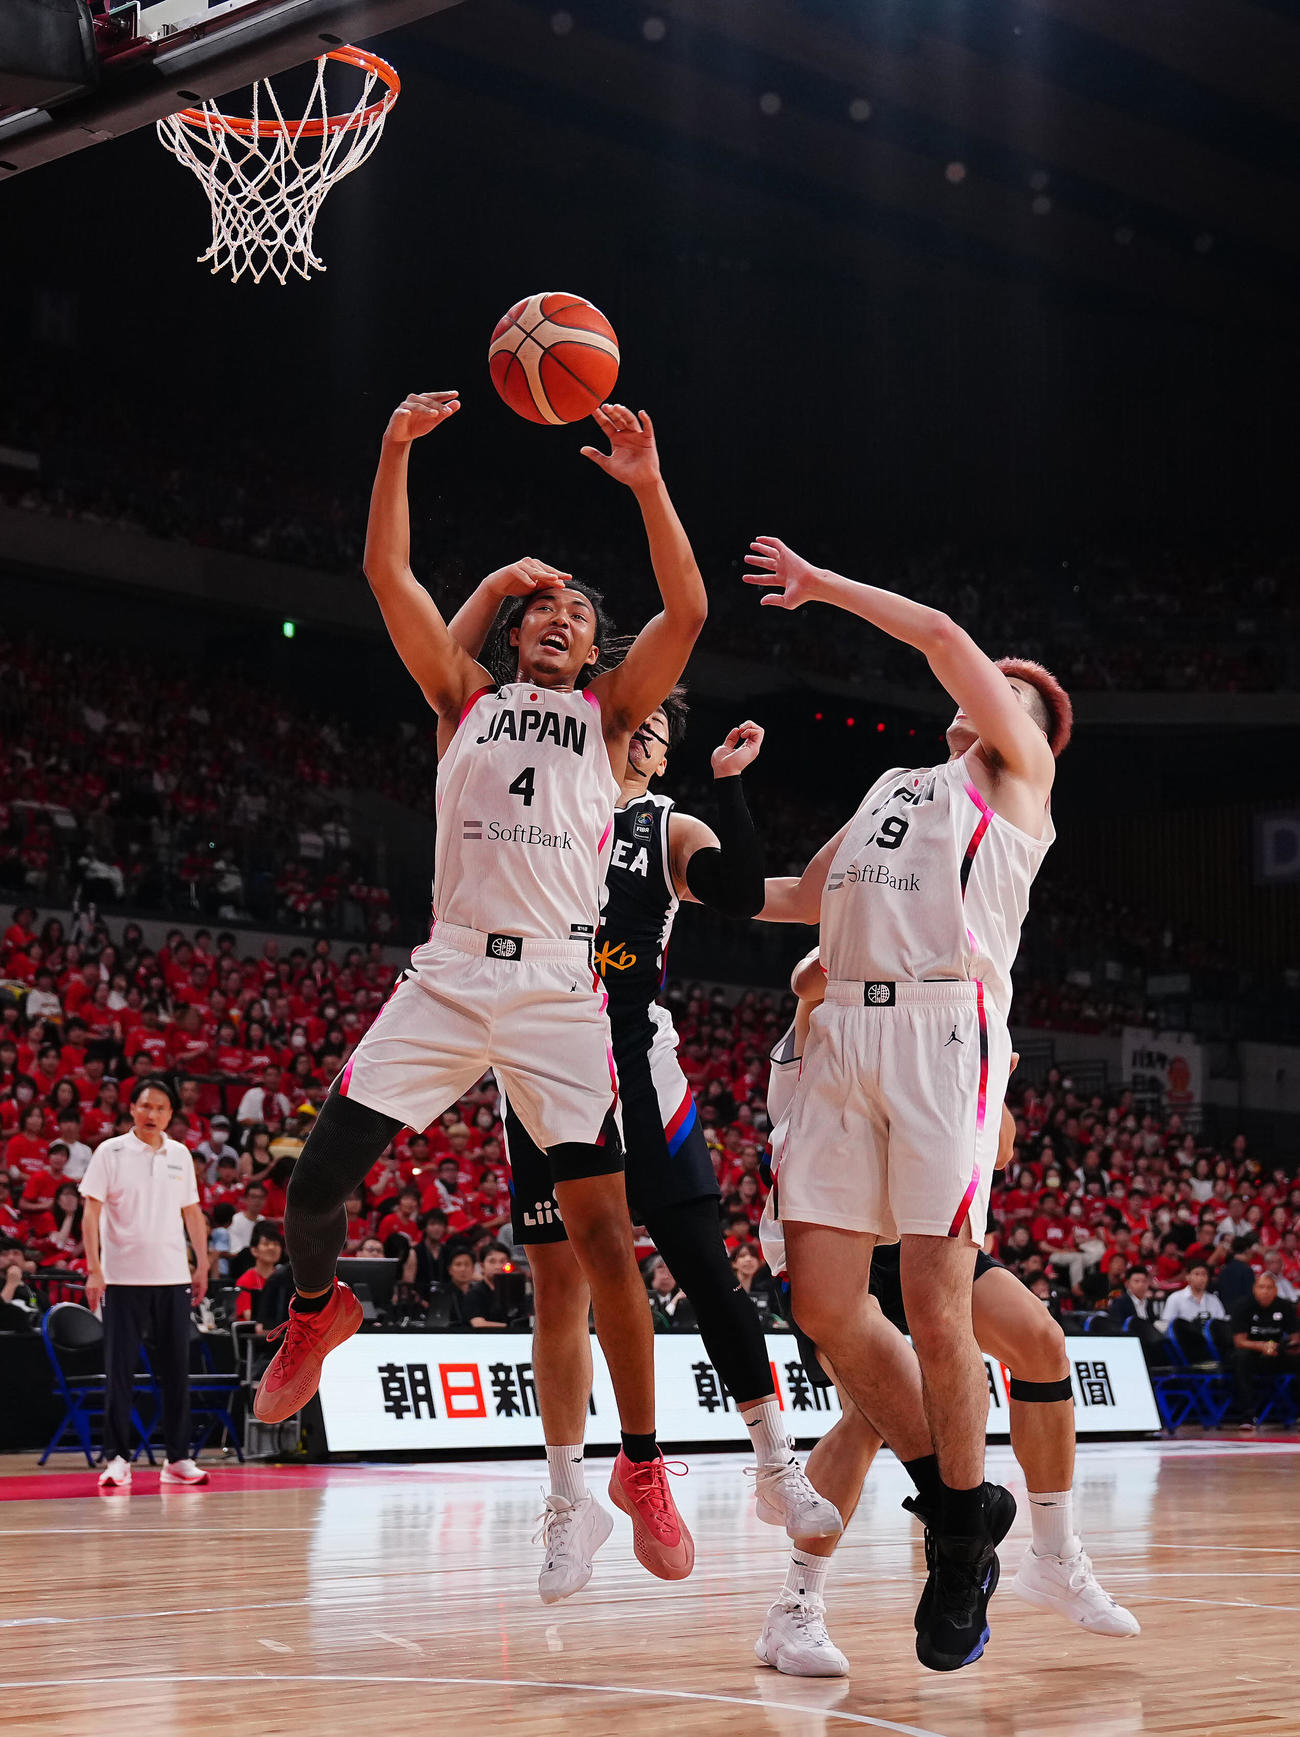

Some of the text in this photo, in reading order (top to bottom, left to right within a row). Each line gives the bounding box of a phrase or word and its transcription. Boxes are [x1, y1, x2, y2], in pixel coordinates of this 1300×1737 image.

[476, 709, 587, 757] JAPAN
[508, 767, 536, 807] 4
[487, 821, 573, 850] SoftBank
[378, 1362, 598, 1420] 朝日新
